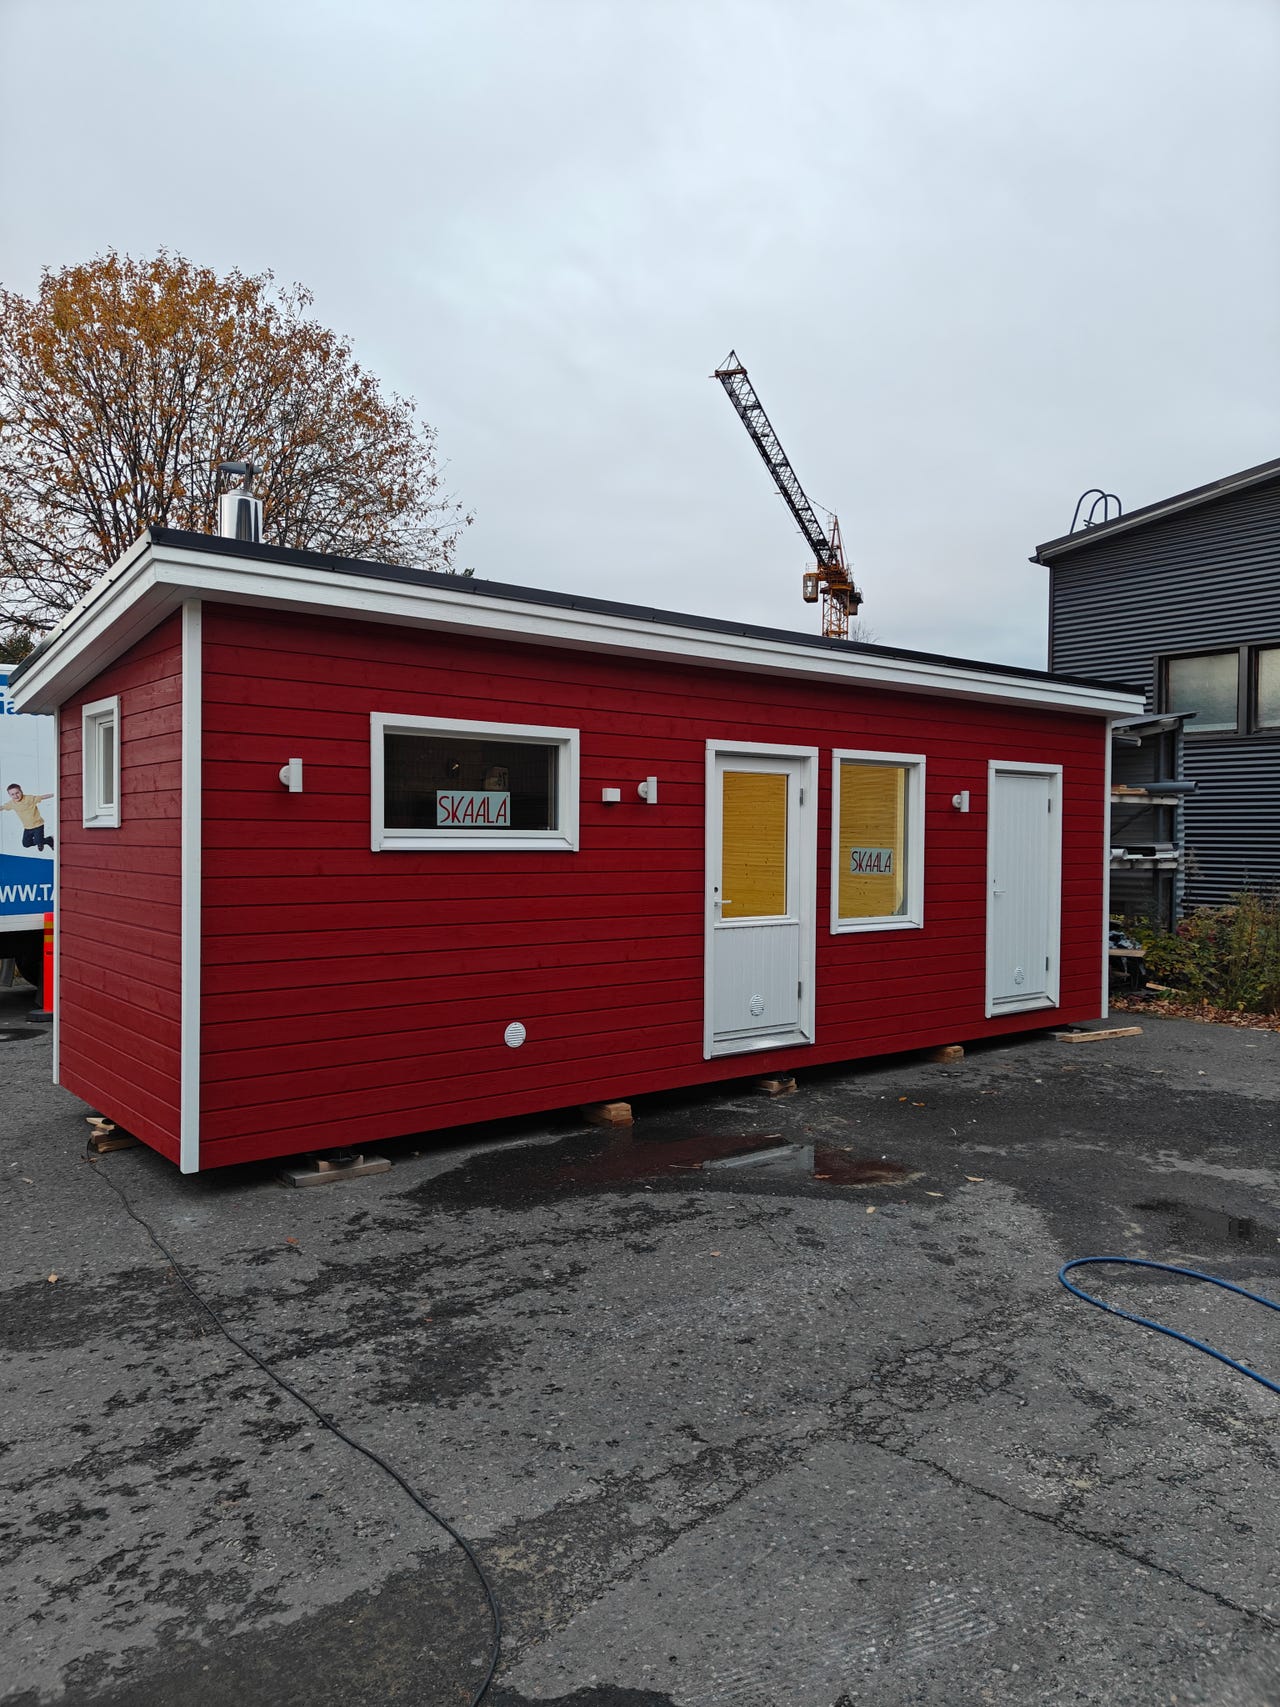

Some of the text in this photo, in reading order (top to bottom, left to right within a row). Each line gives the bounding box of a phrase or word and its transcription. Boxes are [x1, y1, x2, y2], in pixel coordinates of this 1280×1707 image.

[438, 795, 508, 824] SKAALA
[851, 850, 892, 873] SKAALA
[0, 884, 54, 903] WW.T
